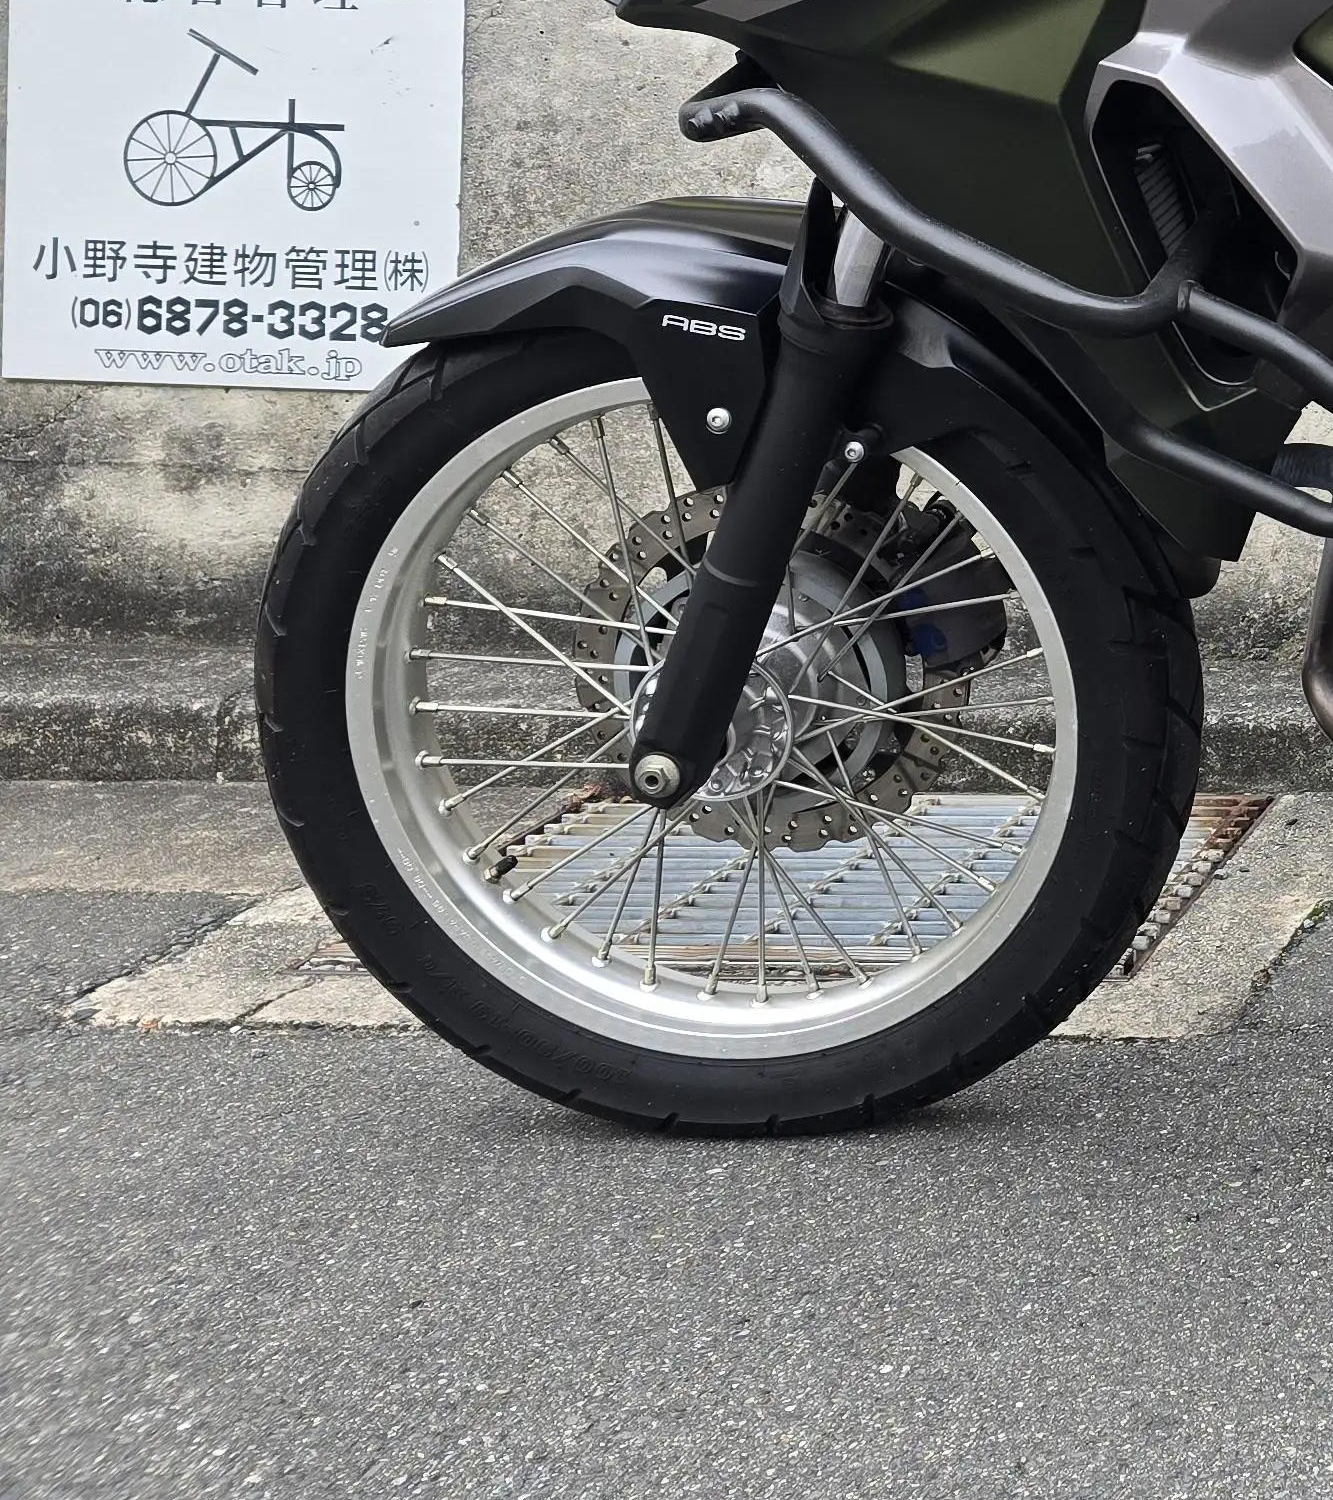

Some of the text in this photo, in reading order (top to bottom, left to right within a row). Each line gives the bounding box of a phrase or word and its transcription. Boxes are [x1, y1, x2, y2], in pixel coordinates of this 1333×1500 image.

[71, 295, 389, 343] (06)6878-3328
[661, 314, 747, 341] ABS
[94, 348, 363, 382] www.otak.jp
